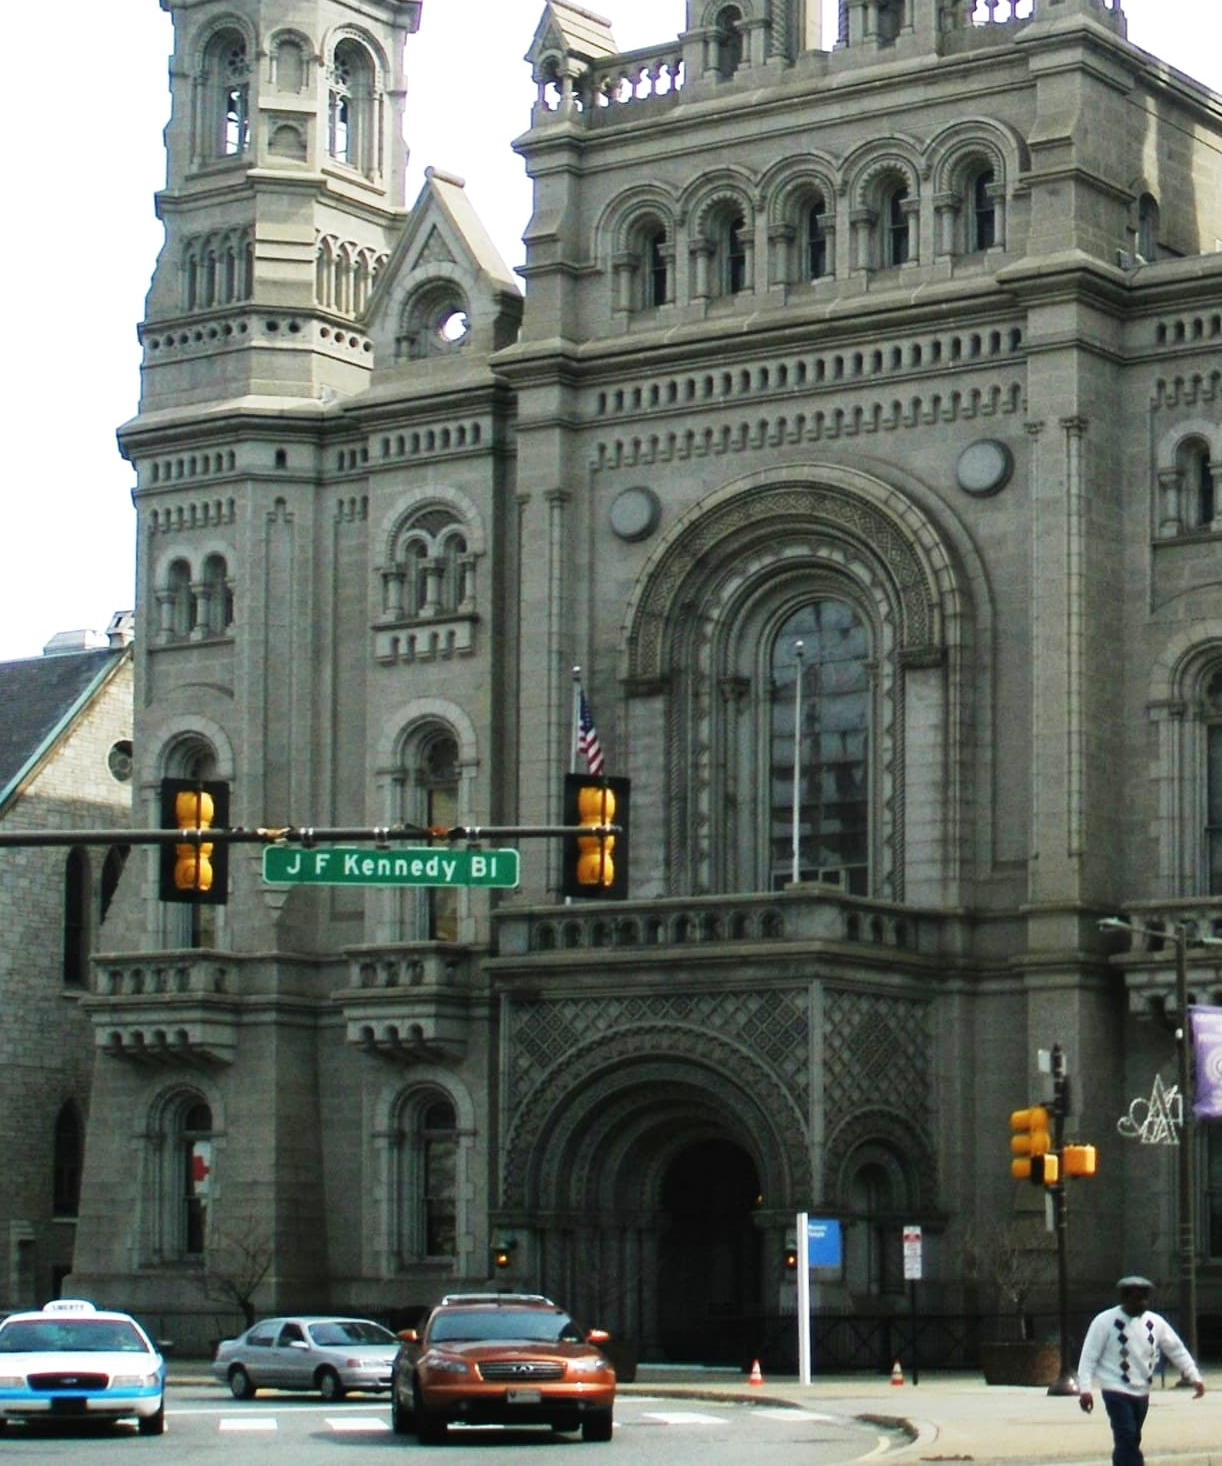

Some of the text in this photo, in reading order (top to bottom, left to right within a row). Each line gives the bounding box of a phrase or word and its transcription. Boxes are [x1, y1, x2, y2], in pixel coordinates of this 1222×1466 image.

[286, 853, 498, 882] J F Kennedy Bl
